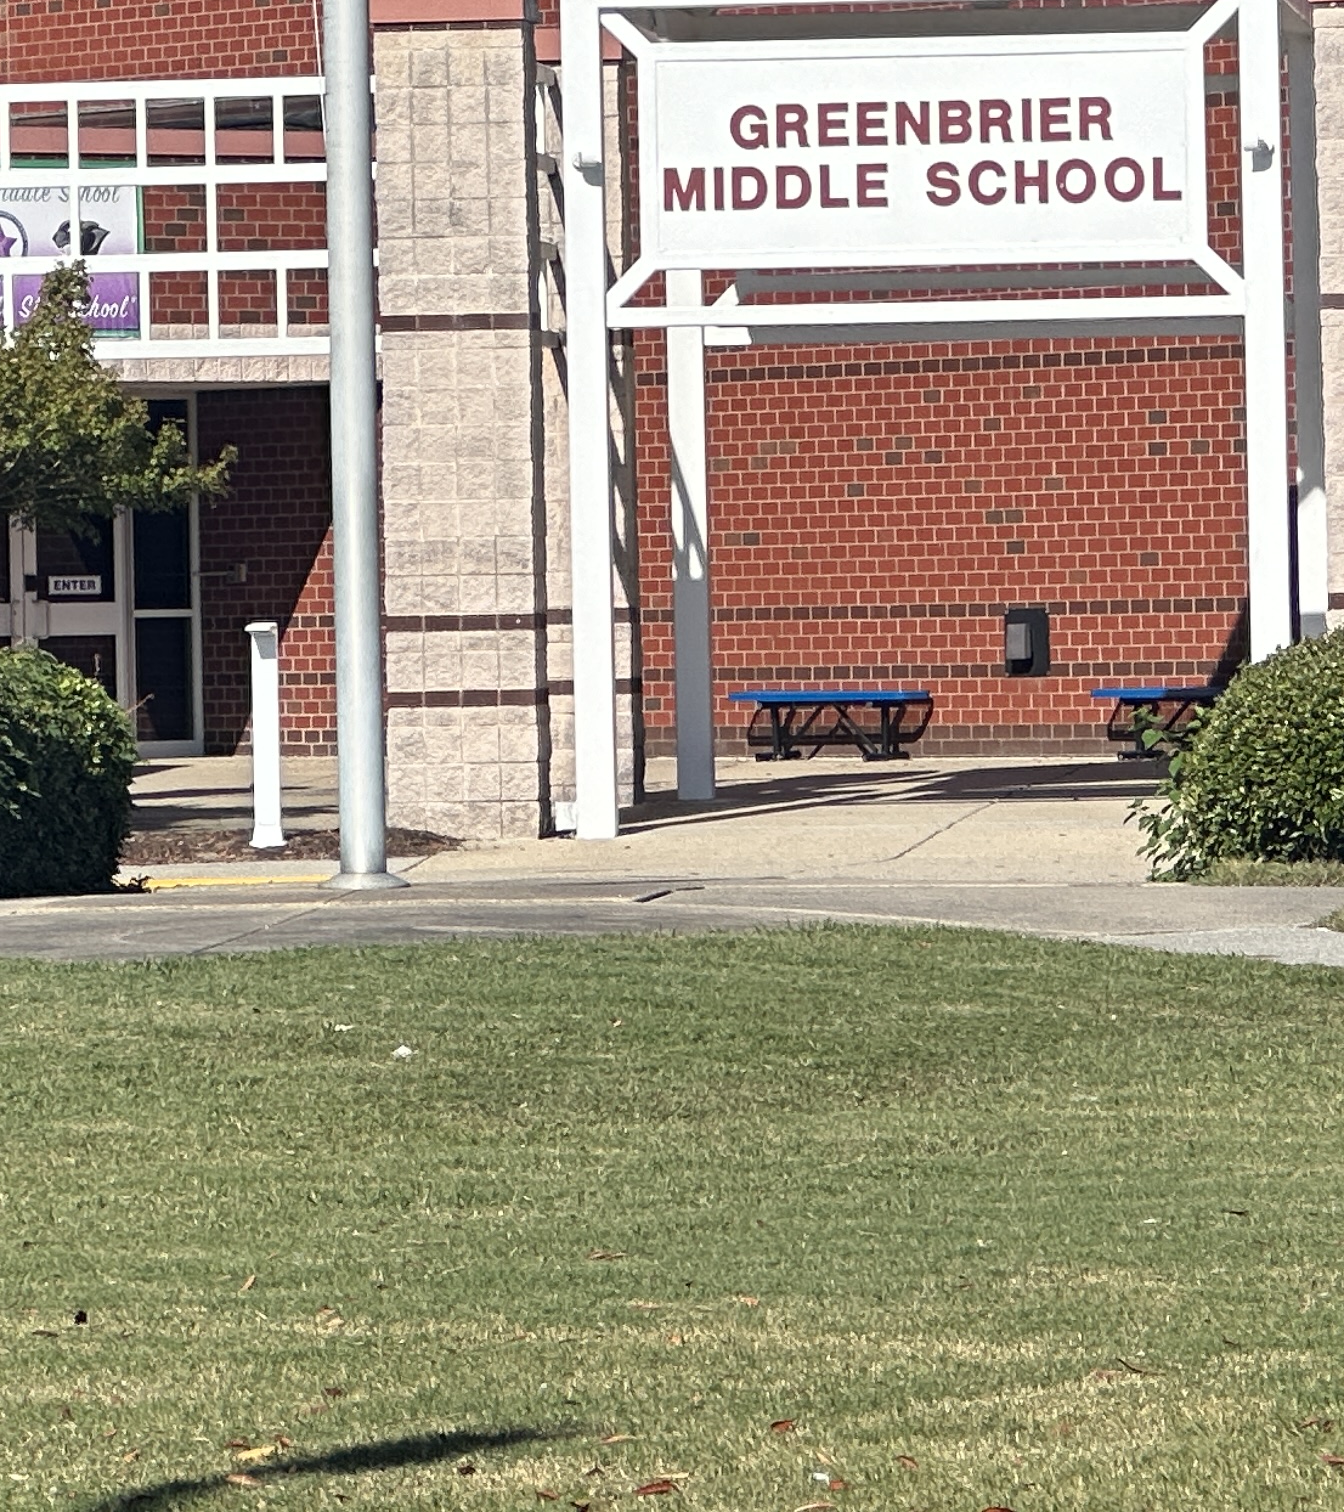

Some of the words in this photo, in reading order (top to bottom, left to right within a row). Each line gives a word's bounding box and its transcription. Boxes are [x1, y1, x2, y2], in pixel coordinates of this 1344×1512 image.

[729, 96, 1114, 150] GREENBRIER
[663, 162, 889, 212] MIDDLE
[925, 156, 1183, 207] SCHOOL
[53, 579, 97, 592] ENTER
